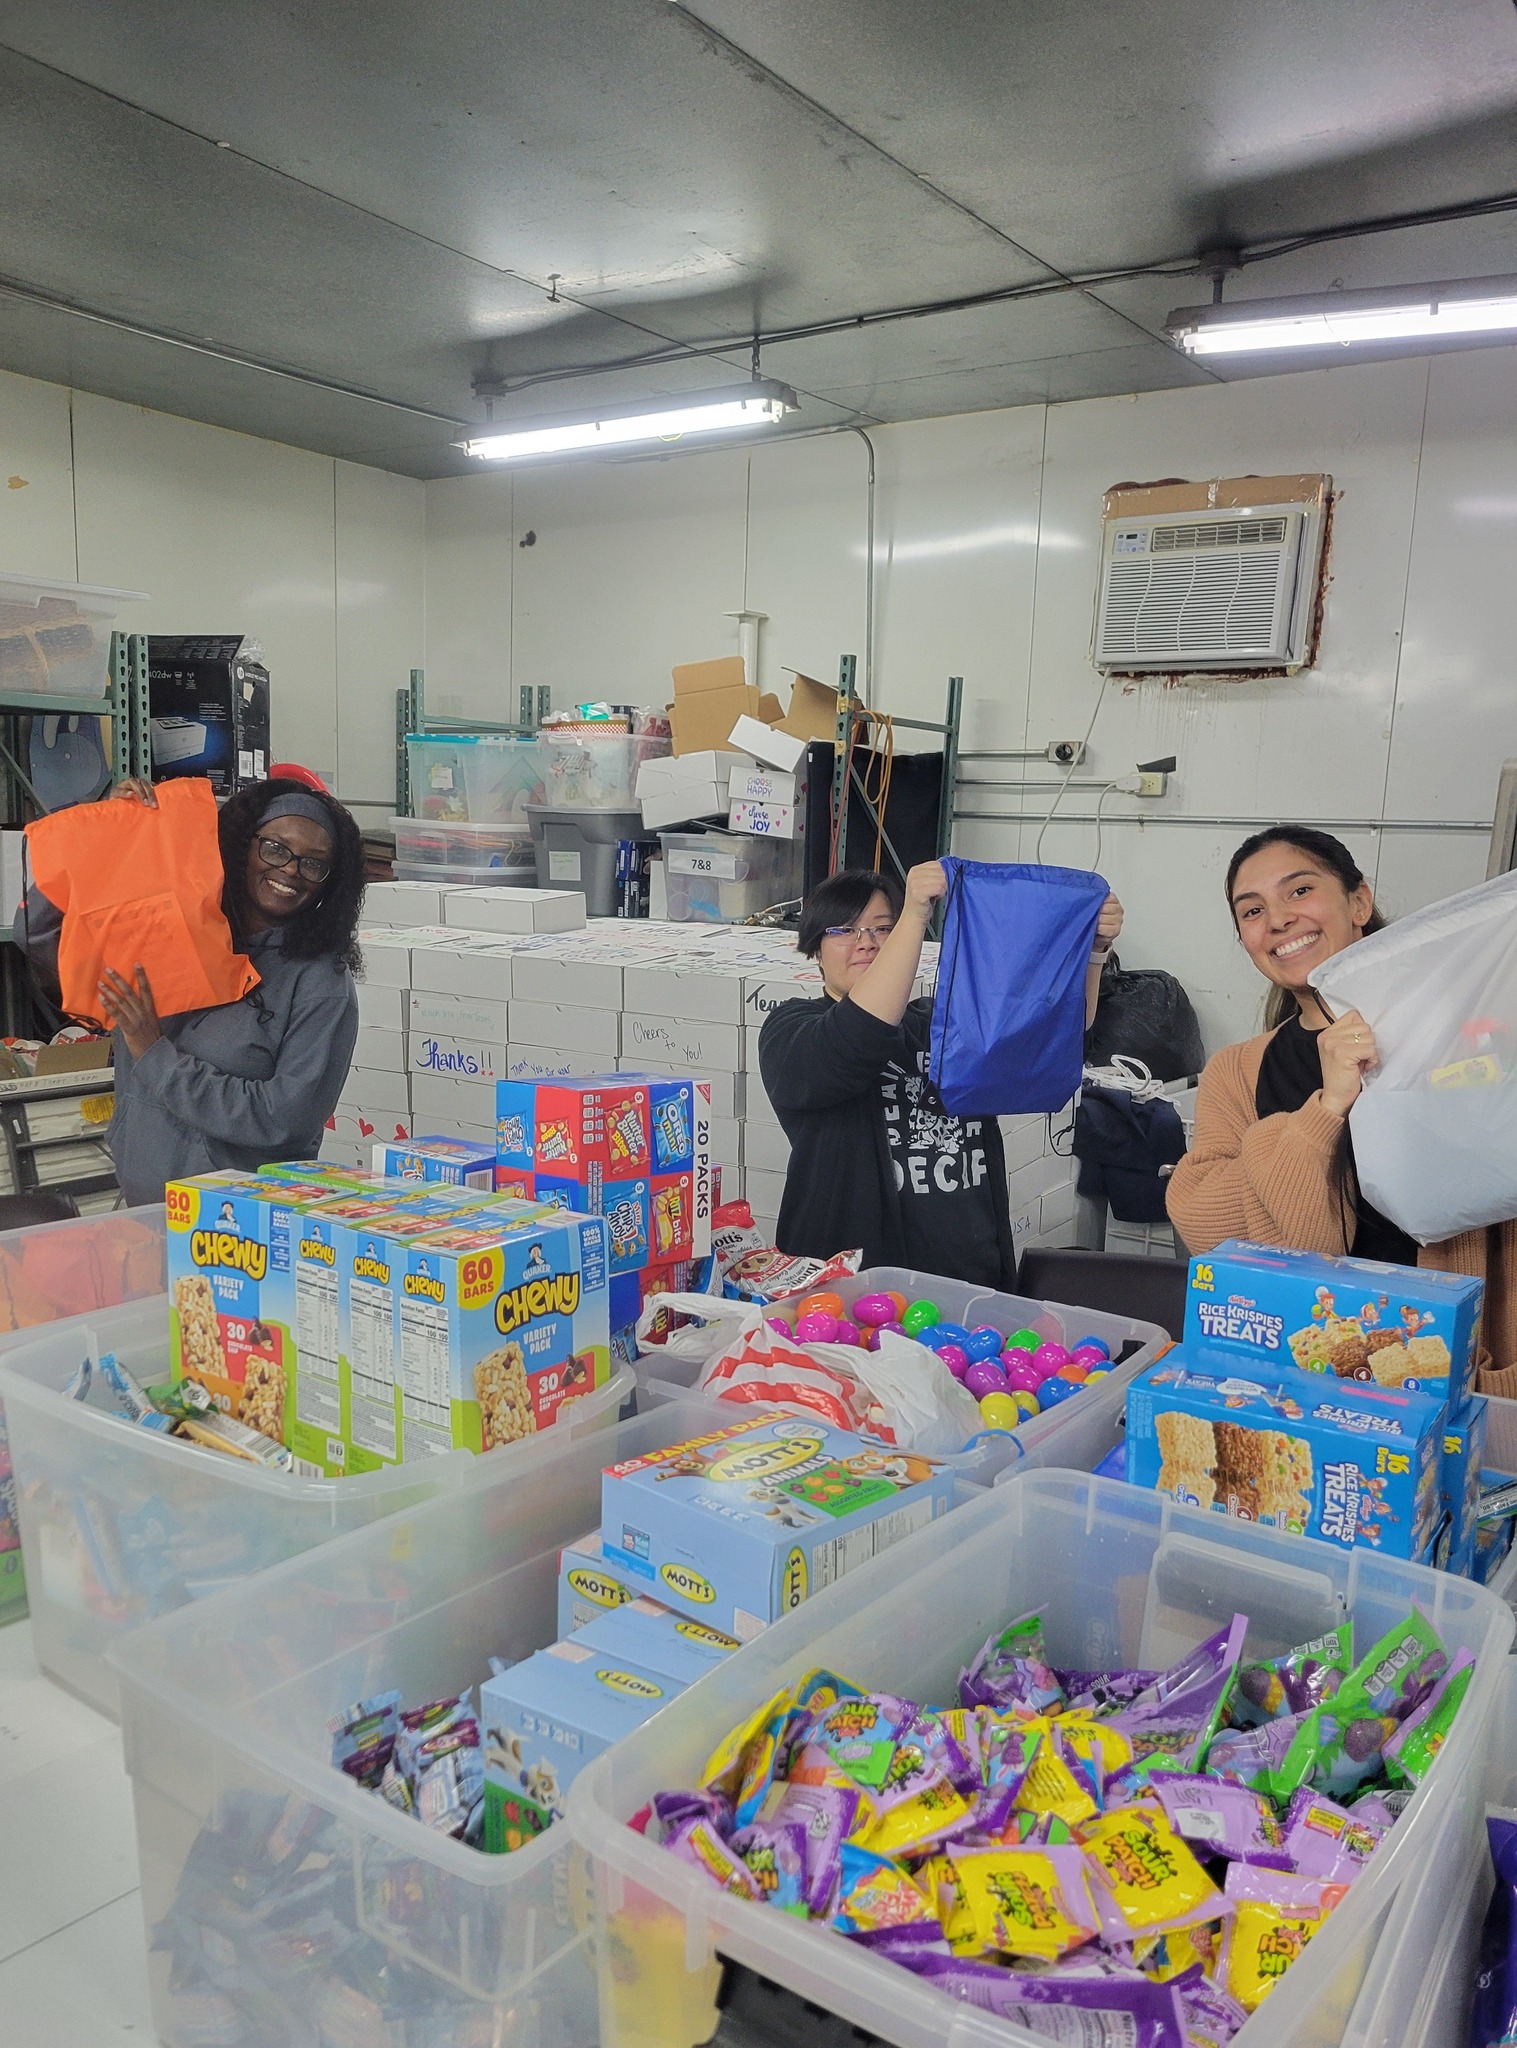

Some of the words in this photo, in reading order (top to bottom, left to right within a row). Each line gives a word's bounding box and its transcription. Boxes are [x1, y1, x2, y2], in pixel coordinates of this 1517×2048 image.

[746, 786, 773, 797] HAPPY
[747, 777, 773, 787] CHOOSE
[749, 820, 771, 833] JOY
[692, 859, 712, 871] 7&8
[632, 1021, 669, 1044] Cheers
[665, 1039, 676, 1050] to
[682, 1042, 703, 1062] You!
[616, 1119, 639, 1154] Butter
[625, 1110, 645, 1147] Nutter
[662, 1120, 679, 1152] mini
[667, 1103, 685, 1155] OREO
[697, 1120, 709, 1146] 20
[611, 1130, 629, 1157] Bites
[696, 1153, 709, 1219] PACKS
[166, 1189, 190, 1212] 60
[168, 1211, 191, 1224] BARS
[616, 1201, 635, 1233] Chips
[672, 1219, 682, 1245] bits
[713, 1231, 744, 1248] ott's
[462, 1256, 493, 1285] 60
[523, 1264, 551, 1280] QUAKER
[1196, 1264, 1214, 1282] 16
[213, 1274, 244, 1291] VARIETY
[218, 1287, 239, 1301] PACK
[463, 1282, 494, 1299] BARS
[1192, 1279, 1215, 1291] Bars
[319, 1290, 328, 1298] 100
[329, 1293, 338, 1301] 100
[373, 1310, 382, 1318] 100
[383, 1313, 393, 1321] 100
[1199, 1302, 1226, 1317] RICE
[1227, 1305, 1282, 1330] KRISPIES
[226, 1322, 246, 1341] 30
[427, 1330, 437, 1338] 100
[438, 1333, 448, 1341] 100
[523, 1323, 558, 1345] VARIETY
[1200, 1315, 1279, 1349] TREATS
[530, 1338, 551, 1355] PACK
[1314, 1362, 1321, 1371] 4
[1359, 1371, 1366, 1380] 4
[539, 1373, 559, 1395] 30
[1408, 1380, 1415, 1389] 8
[539, 1389, 566, 1405] CHOCOLATE
[1319, 1404, 1399, 1430] TREATS
[613, 1459, 644, 1474] 40
[643, 1429, 731, 1462] FAMILY
[730, 1410, 791, 1434] PACK
[1444, 1436, 1462, 1454] 16
[721, 1440, 811, 1478] MOTT'S
[760, 1453, 834, 1487] ANIMALS
[1376, 1446, 1389, 1473] Bars
[1388, 1453, 1410, 1474] 16
[1345, 1462, 1358, 1492] RICE
[1320, 1464, 1345, 1537] TREATS
[1341, 1492, 1360, 1543] KRISPIES
[575, 1574, 626, 1604] MOTT'S
[666, 1568, 711, 1598] MOTT'S
[790, 1556, 800, 1608] OTT'S
[682, 1624, 735, 1647] MOTT'S
[603, 1671, 657, 1696] MOTT'S
[1090, 1673, 1111, 1689] SOUR
[1104, 1835, 1158, 1890] PATCH
[1124, 1829, 1171, 1881] SOUR
